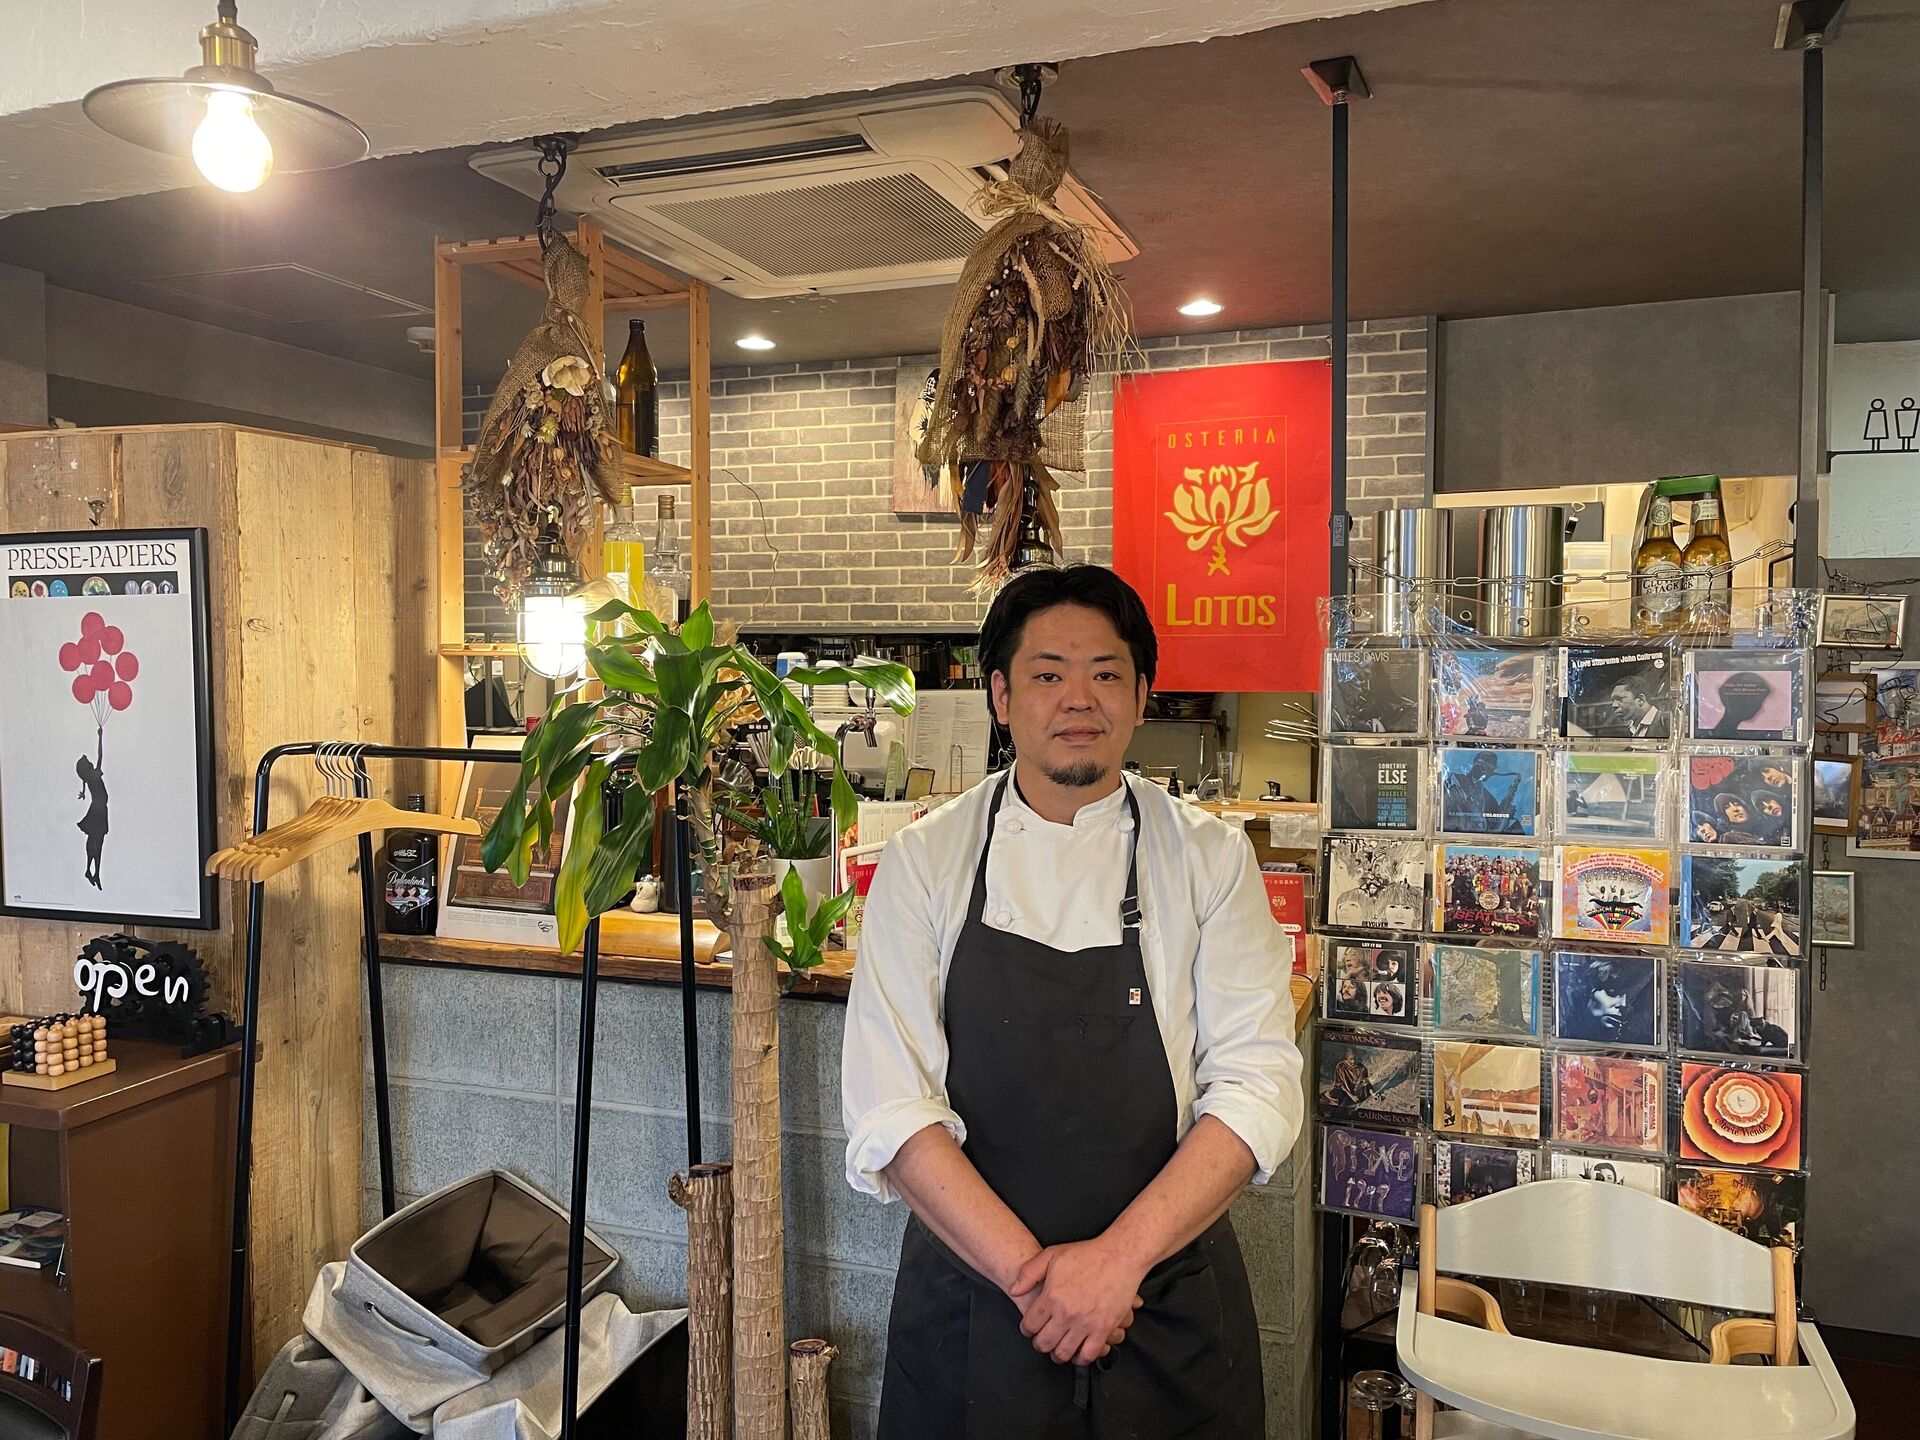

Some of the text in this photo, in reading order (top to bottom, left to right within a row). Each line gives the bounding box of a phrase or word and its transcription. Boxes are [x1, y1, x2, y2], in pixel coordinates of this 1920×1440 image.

[1167, 428, 1276, 449] OSTERIA
[8, 543, 177, 570] PRESSE-PAPIERS
[1167, 584, 1276, 626] LOTOS
[1333, 652, 1390, 662] MILES DAVIS
[1620, 655, 1636, 664] John
[1636, 651, 1663, 662] Coltrane
[1377, 770, 1408, 785] ELSE
[73, 959, 189, 1012] open
